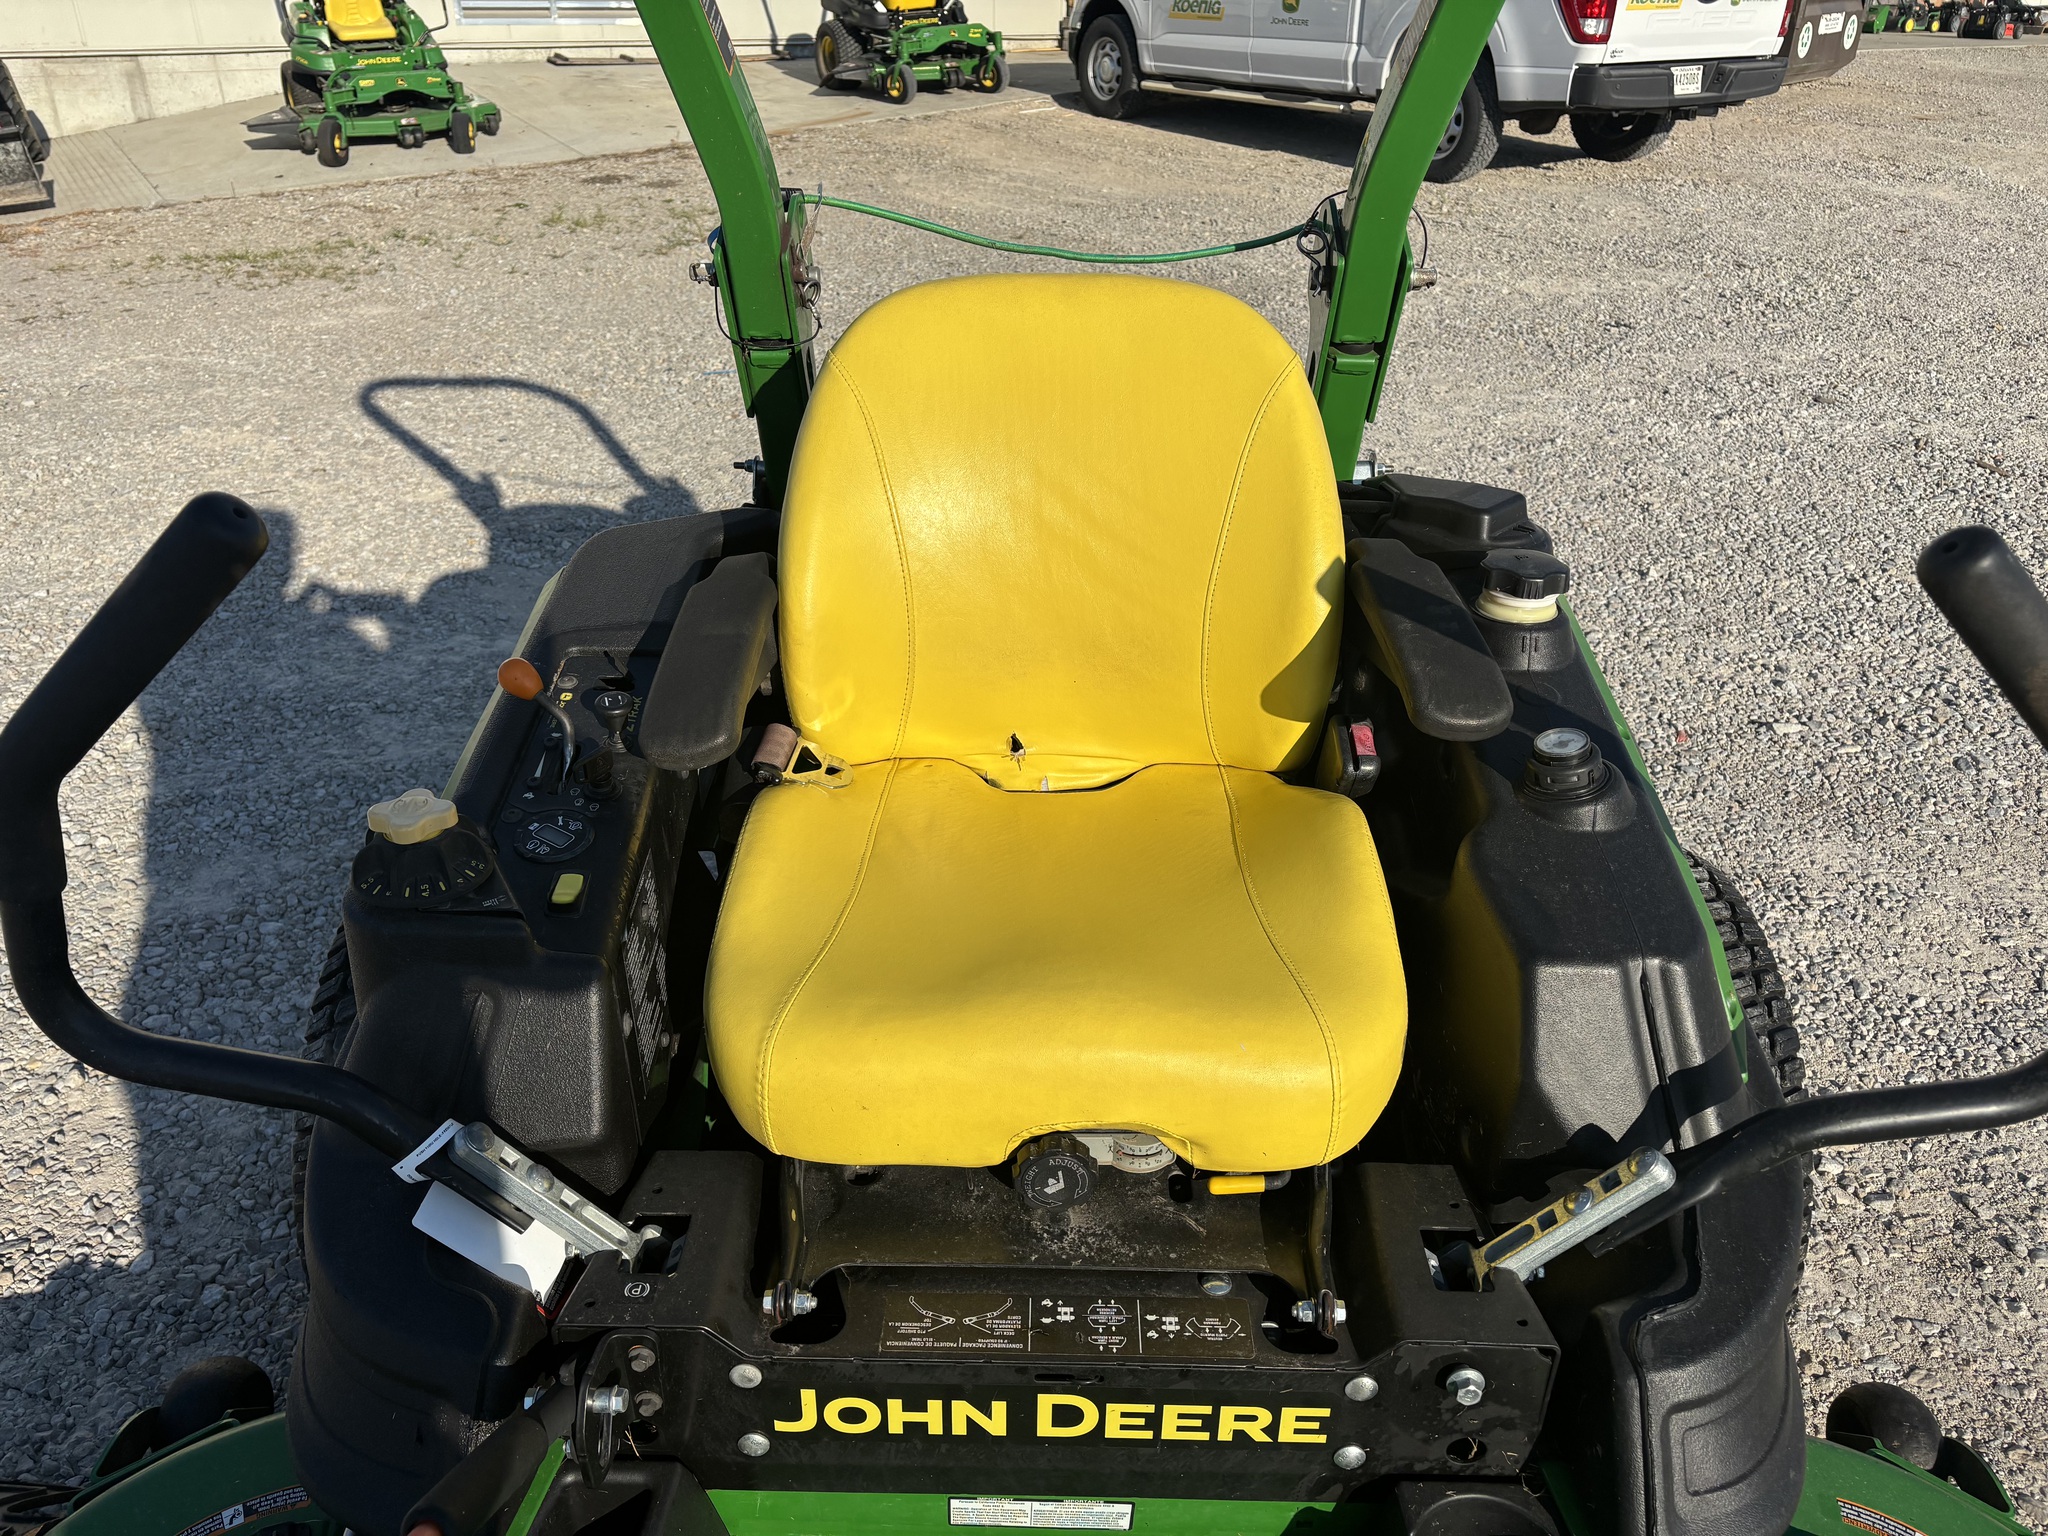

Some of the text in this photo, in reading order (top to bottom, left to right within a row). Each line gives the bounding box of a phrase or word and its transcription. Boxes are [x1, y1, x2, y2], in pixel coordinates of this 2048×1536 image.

[1270, 16, 1309, 26] JOHN DEERE
[357, 56, 401, 66] JOHN DEERE
[1024, 1158, 1085, 1198] WEIGHT ADJUST
[774, 1388, 1331, 1443] JOHN DEERE
[1842, 1518, 1886, 1536] ADVERTENCI
